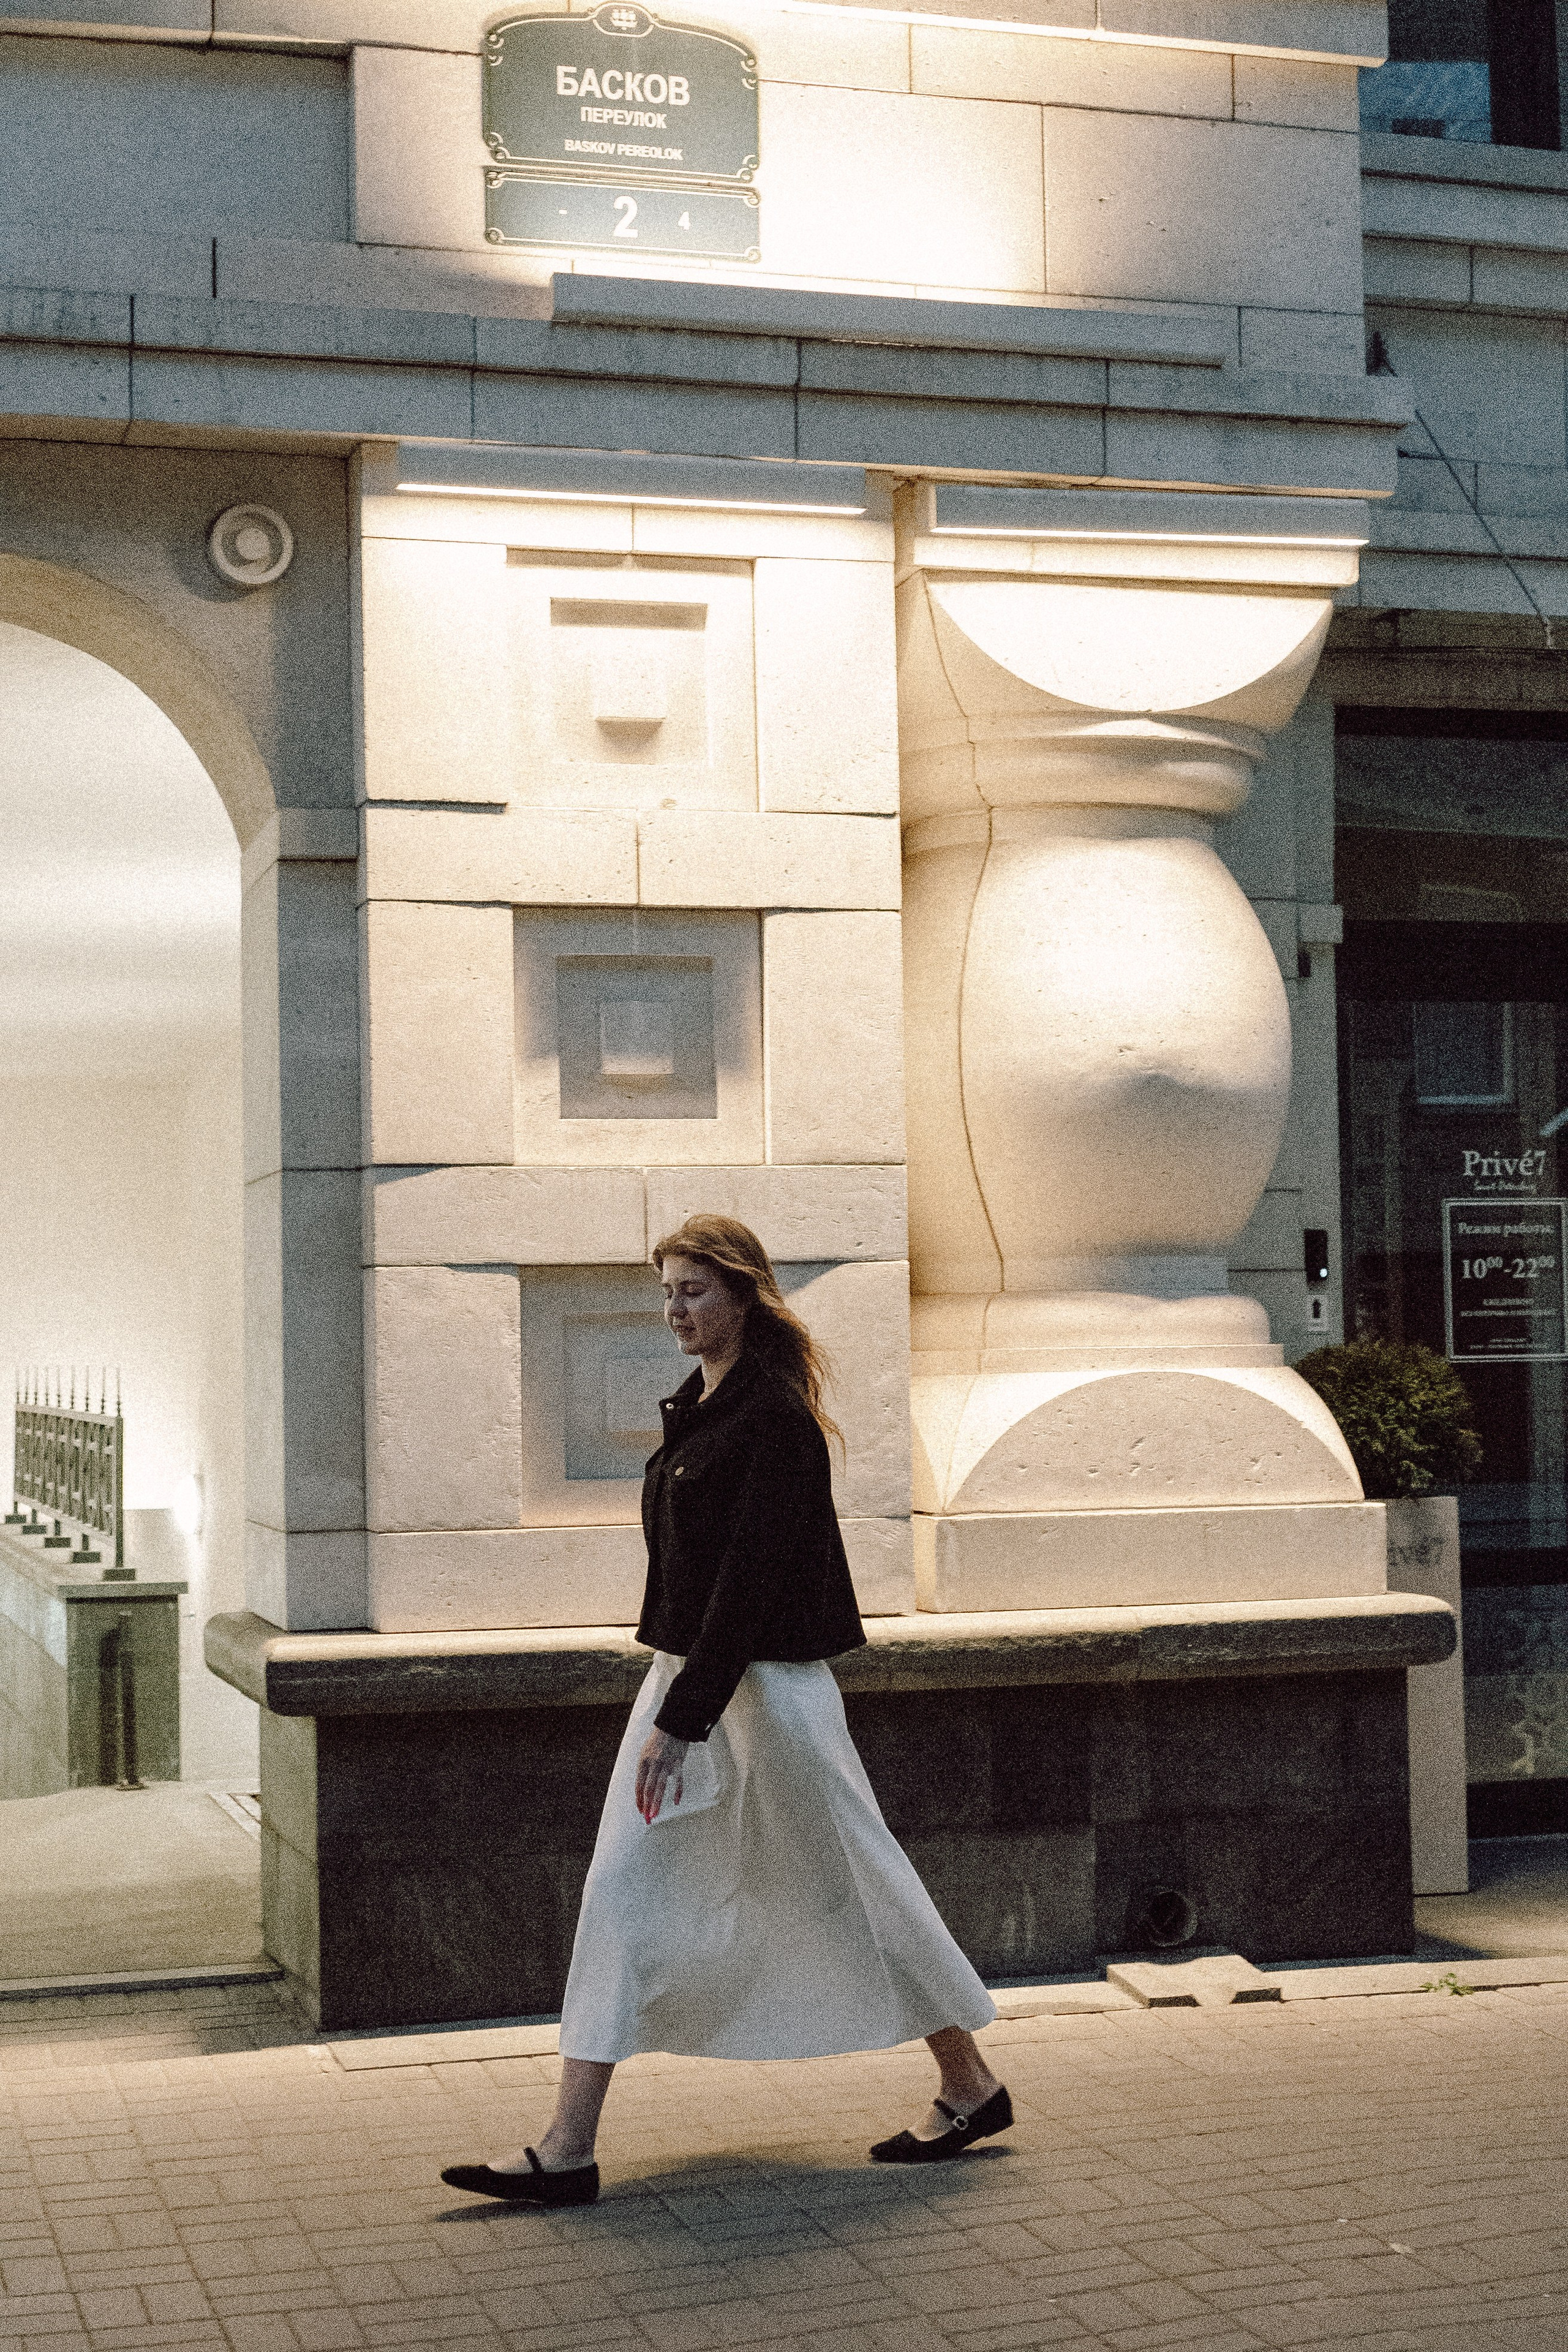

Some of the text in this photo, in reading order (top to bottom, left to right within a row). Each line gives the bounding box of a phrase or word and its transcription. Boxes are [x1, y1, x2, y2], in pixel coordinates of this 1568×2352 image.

[556, 66, 691, 106] БАСКОВ
[581, 107, 667, 129] ПЕРЕУЛОК
[564, 139, 616, 155] BASKOV
[613, 195, 639, 238] 2
[677, 211, 692, 230] 4
[1462, 1150, 1547, 1177] Privé7
